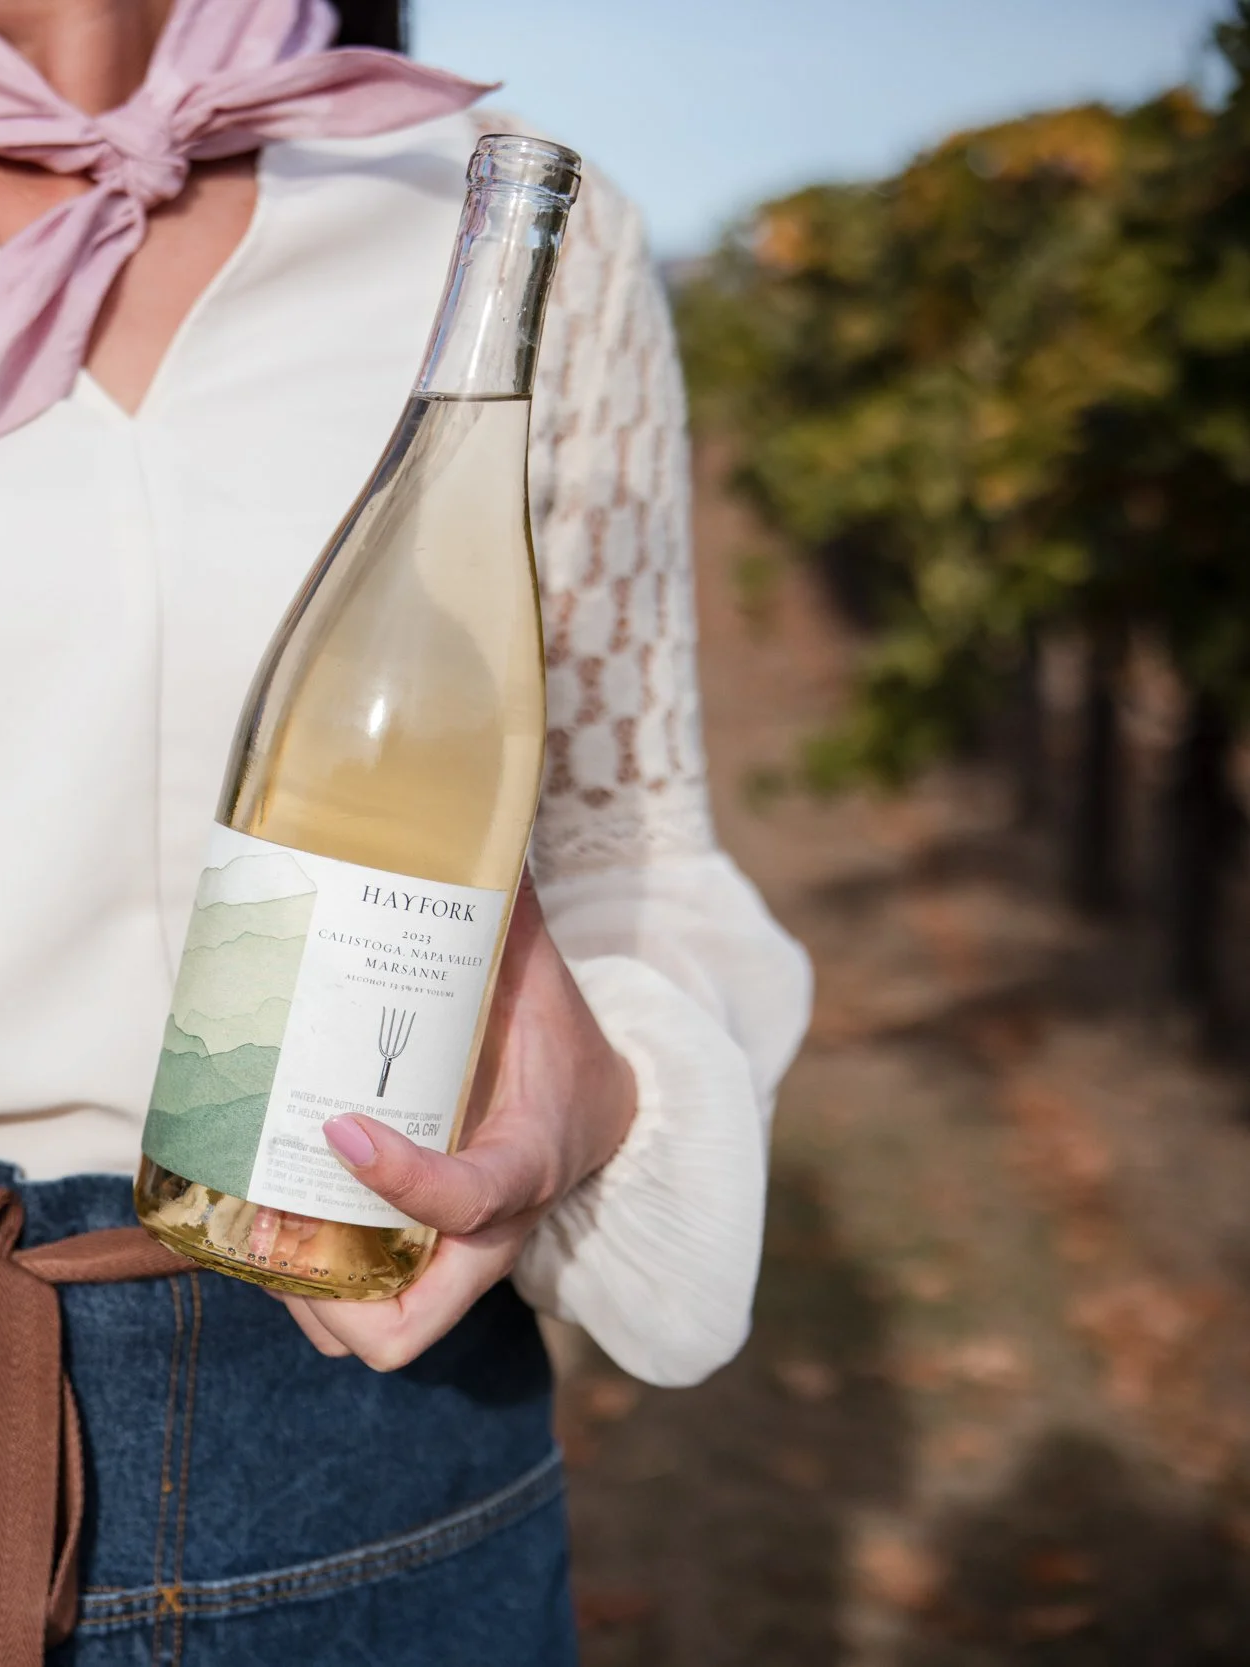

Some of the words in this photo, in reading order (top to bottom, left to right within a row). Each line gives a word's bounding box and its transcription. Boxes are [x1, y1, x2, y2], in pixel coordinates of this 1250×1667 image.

[361, 885, 477, 922] HAYFORK
[402, 931, 432, 945] 2023
[365, 957, 450, 981] MARSANNE
[411, 948, 444, 963] NAPA
[448, 954, 484, 968] VALLEY
[345, 974, 387, 988] ALCOHOL
[427, 987, 455, 998] VOLUME
[317, 1095, 333, 1107] AND
[334, 1098, 365, 1113] BOTTLED
[365, 1105, 375, 1115] BY
[376, 1107, 403, 1119] HAYFORK
[406, 1122, 420, 1136] CA
[422, 1123, 441, 1137] CRV
